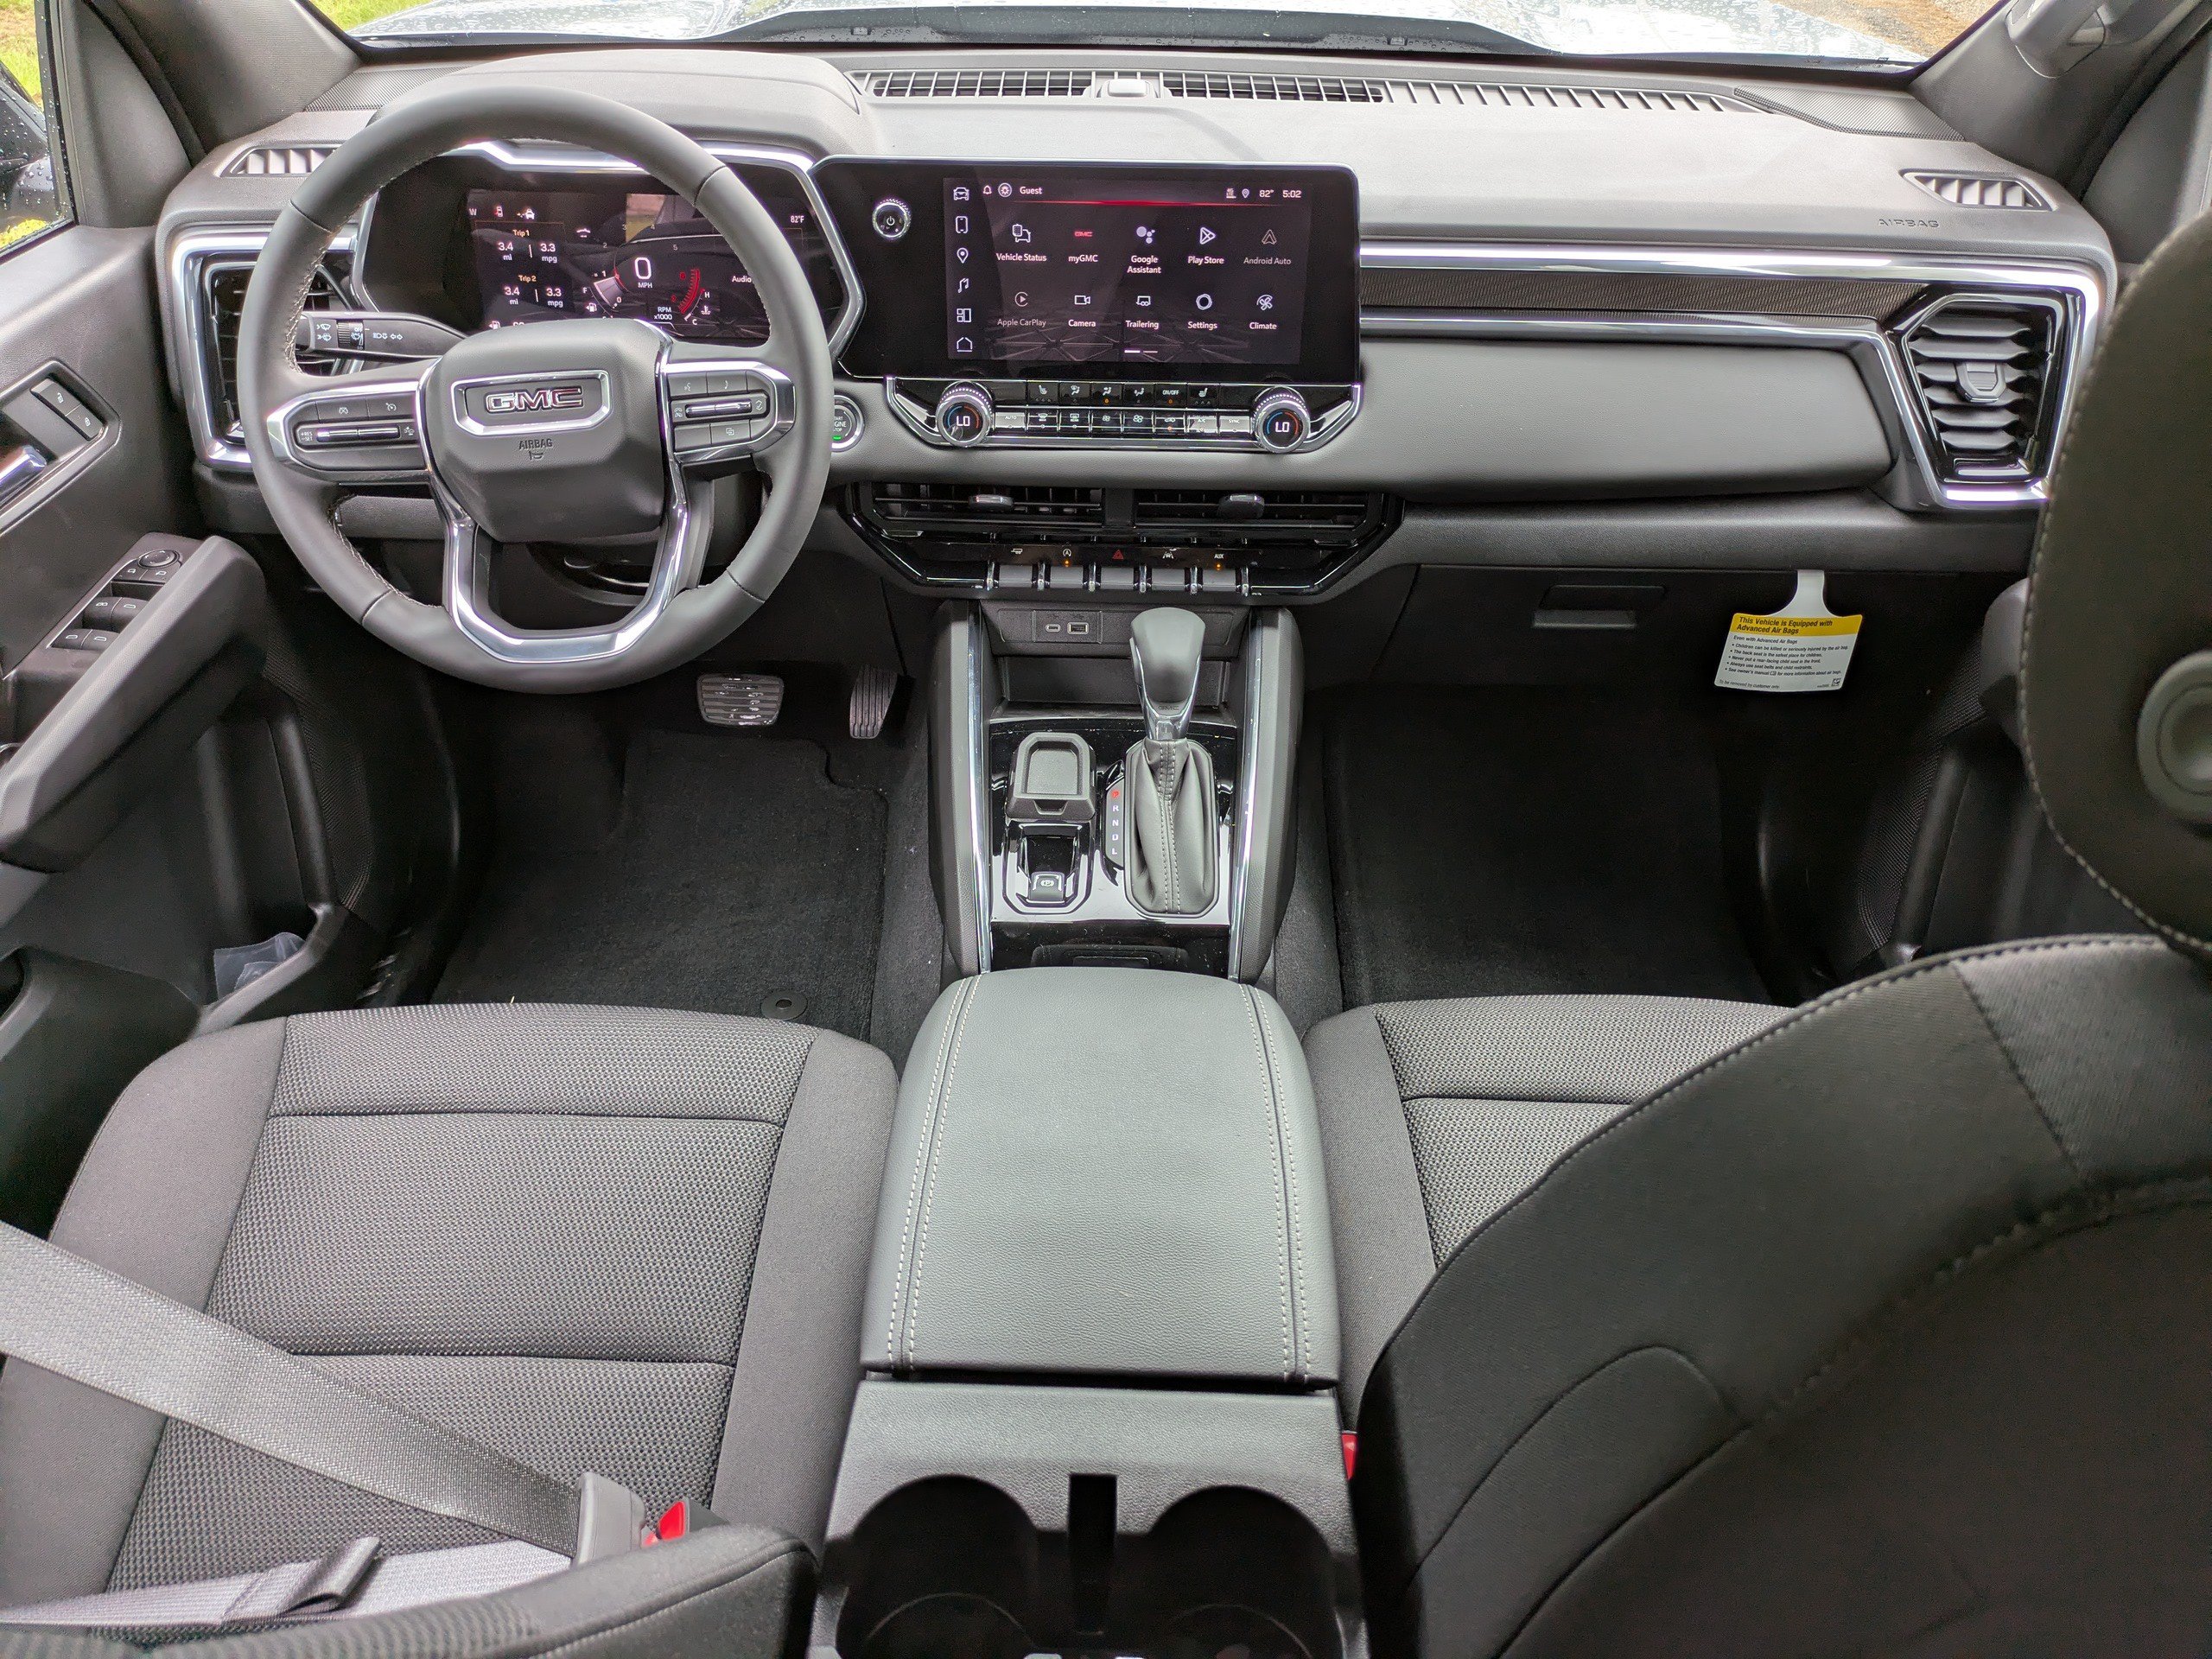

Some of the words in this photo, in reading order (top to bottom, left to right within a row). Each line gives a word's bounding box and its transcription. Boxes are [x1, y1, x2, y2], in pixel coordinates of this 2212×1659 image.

[1878, 219, 1939, 228] AIRBAG
[498, 242, 513, 251] 3.4
[1024, 253, 1047, 262] Status
[1068, 255, 1098, 264] myGMC
[1131, 255, 1159, 264] Google
[1187, 256, 1203, 265] Play
[635, 257, 652, 279] 0
[505, 287, 520, 296] 3.4
[546, 289, 562, 297] 3.3
[1020, 319, 1046, 327] CarPlay
[1125, 321, 1160, 329] Trailering
[1187, 321, 1217, 330] Settings
[1249, 321, 1277, 330] Climate
[486, 387, 583, 413] GMC
[957, 416, 970, 426] LO
[1275, 422, 1289, 432] LO
[518, 439, 553, 449] AIRBAG
[1737, 624, 1770, 633] Advanced
